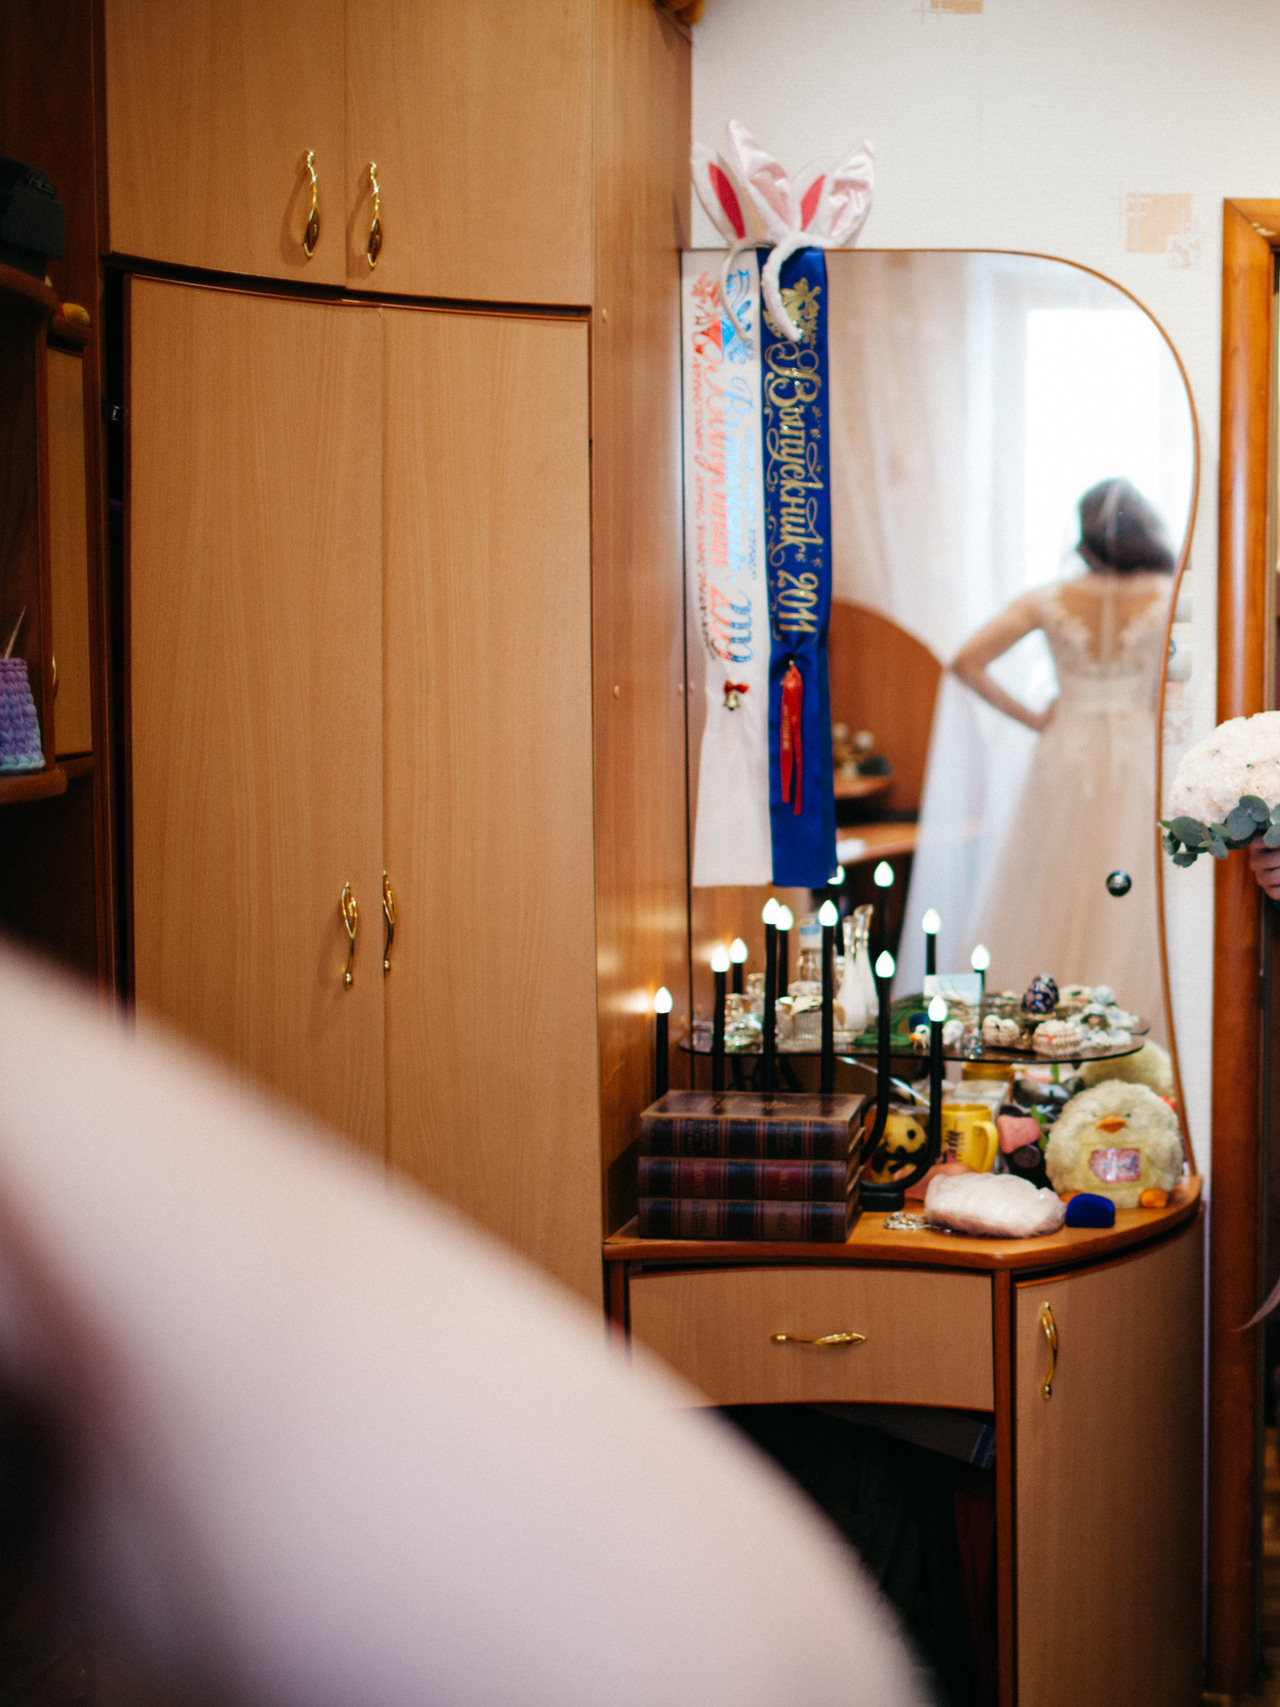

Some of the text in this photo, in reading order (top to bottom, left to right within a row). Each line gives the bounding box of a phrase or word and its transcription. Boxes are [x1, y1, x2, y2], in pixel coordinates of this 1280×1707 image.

[764, 341, 824, 634] Выпускник 2011
[708, 587, 754, 663] 2009
